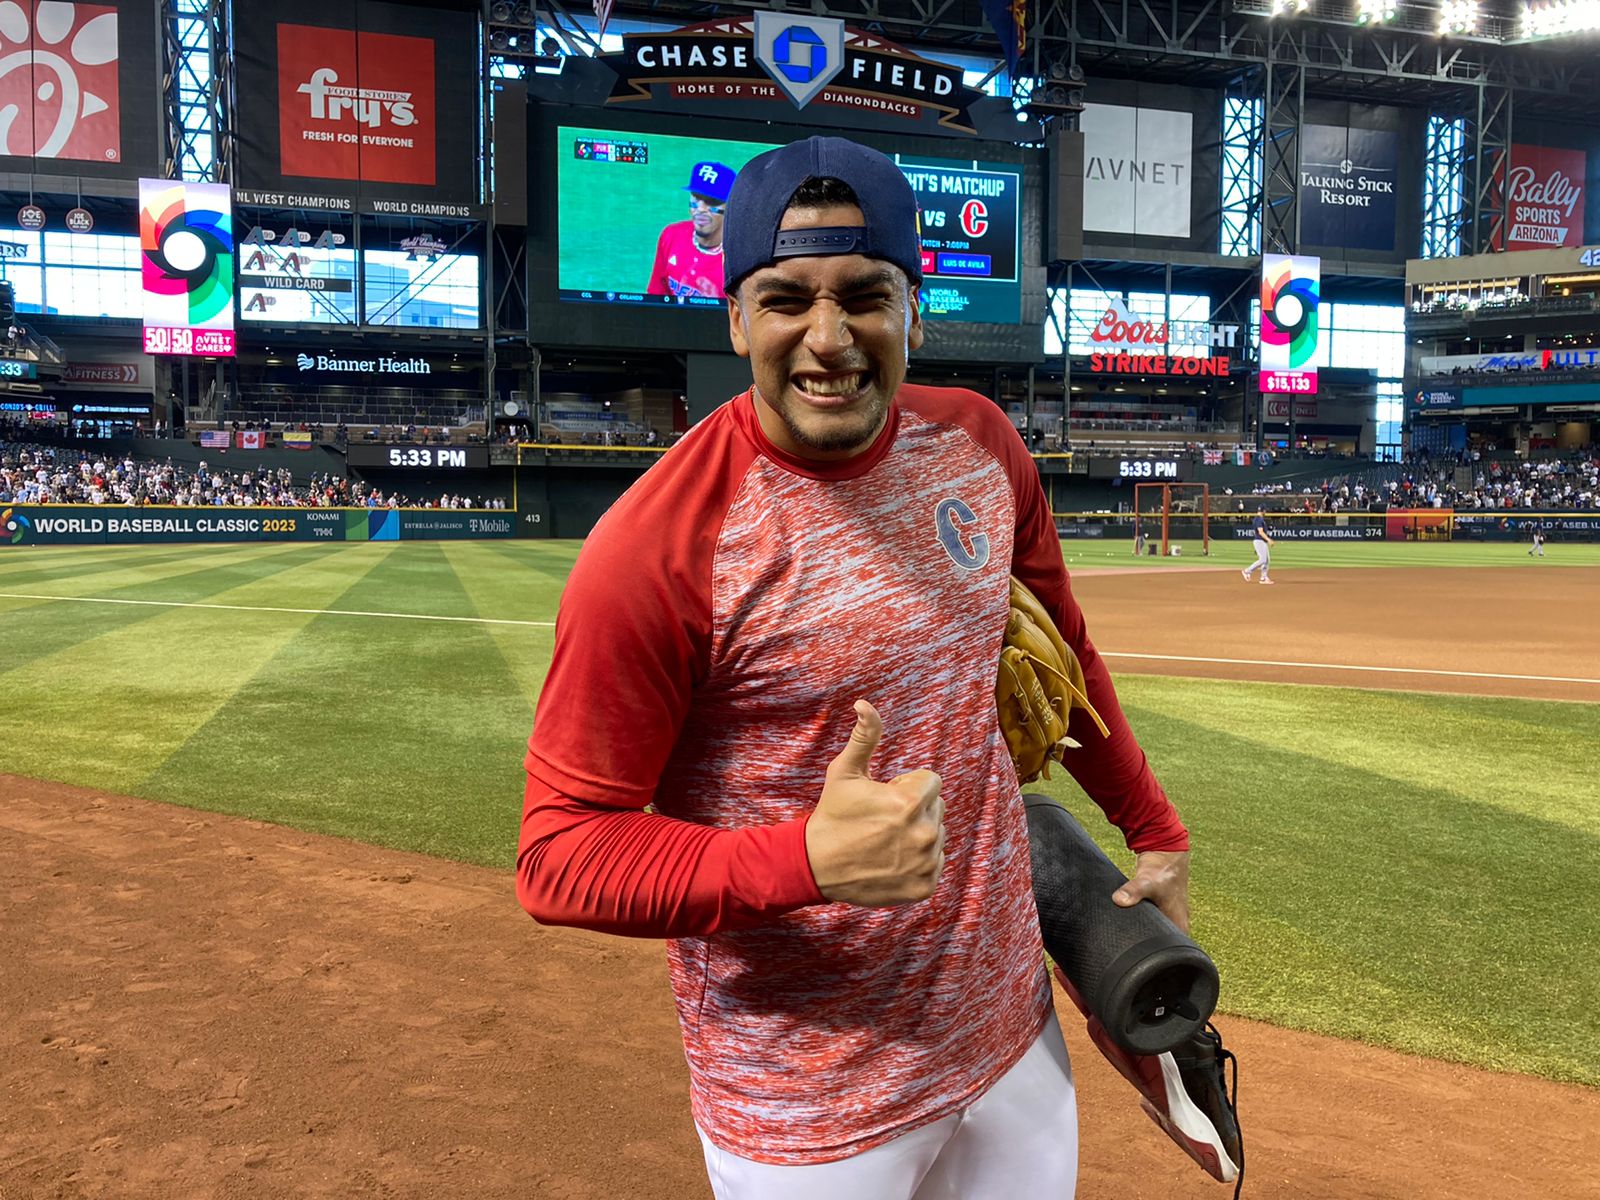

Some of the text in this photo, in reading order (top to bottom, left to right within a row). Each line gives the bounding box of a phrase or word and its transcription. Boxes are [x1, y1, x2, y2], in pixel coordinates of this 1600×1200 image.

[636, 45, 953, 96] CHASE FIELD
[297, 68, 415, 128] fry's
[327, 86, 409, 101] FOOD STORES
[677, 84, 917, 116] HOME OF THE DIAMONDBACKS
[303, 130, 414, 148] FRESH FOR EVERYONE
[1086, 156, 1185, 186] AVNET
[941, 175, 1005, 197] MATCHUP
[1301, 171, 1393, 193] TALKING STICK
[236, 191, 351, 210] NL WEST CHAMPIONS
[1320, 189, 1372, 207] RESORT
[1499, 166, 1582, 218] Bally
[373, 200, 470, 217] WORLD CHAMPIONS
[1515, 206, 1561, 225] SPORTS
[924, 210, 946, 227] VS
[958, 198, 989, 238] C
[1515, 226, 1559, 242] ARIZONA
[922, 239, 941, 248] PITCH
[943, 259, 985, 269] LUIS DE AVILA
[264, 277, 325, 290] WILD CARD
[929, 288, 959, 296] WORLD
[929, 296, 969, 304] BASEBALL
[929, 302, 964, 311] CLASSIC
[1092, 308, 1240, 348] Coors LIGHT
[195, 336, 231, 344] AVNET
[195, 343, 223, 352] CARES
[316, 355, 431, 374] Banner Health
[1090, 352, 1230, 377] STRIKE ZONE
[75, 370, 120, 380] FITNESS
[1267, 376, 1310, 392] $15,133
[389, 449, 466, 467] 5:33 PM
[1120, 461, 1177, 477] 5:33 PM
[34, 519, 297, 533] WORLD BASEBALL CLASSIC 2023
[479, 520, 510, 532] Mobile
[525, 514, 541, 523] 413
[935, 497, 990, 571] C
[1299, 529, 1312, 537] OF
[1313, 529, 1361, 537] BASEBALL
[1365, 528, 1382, 537] 374
